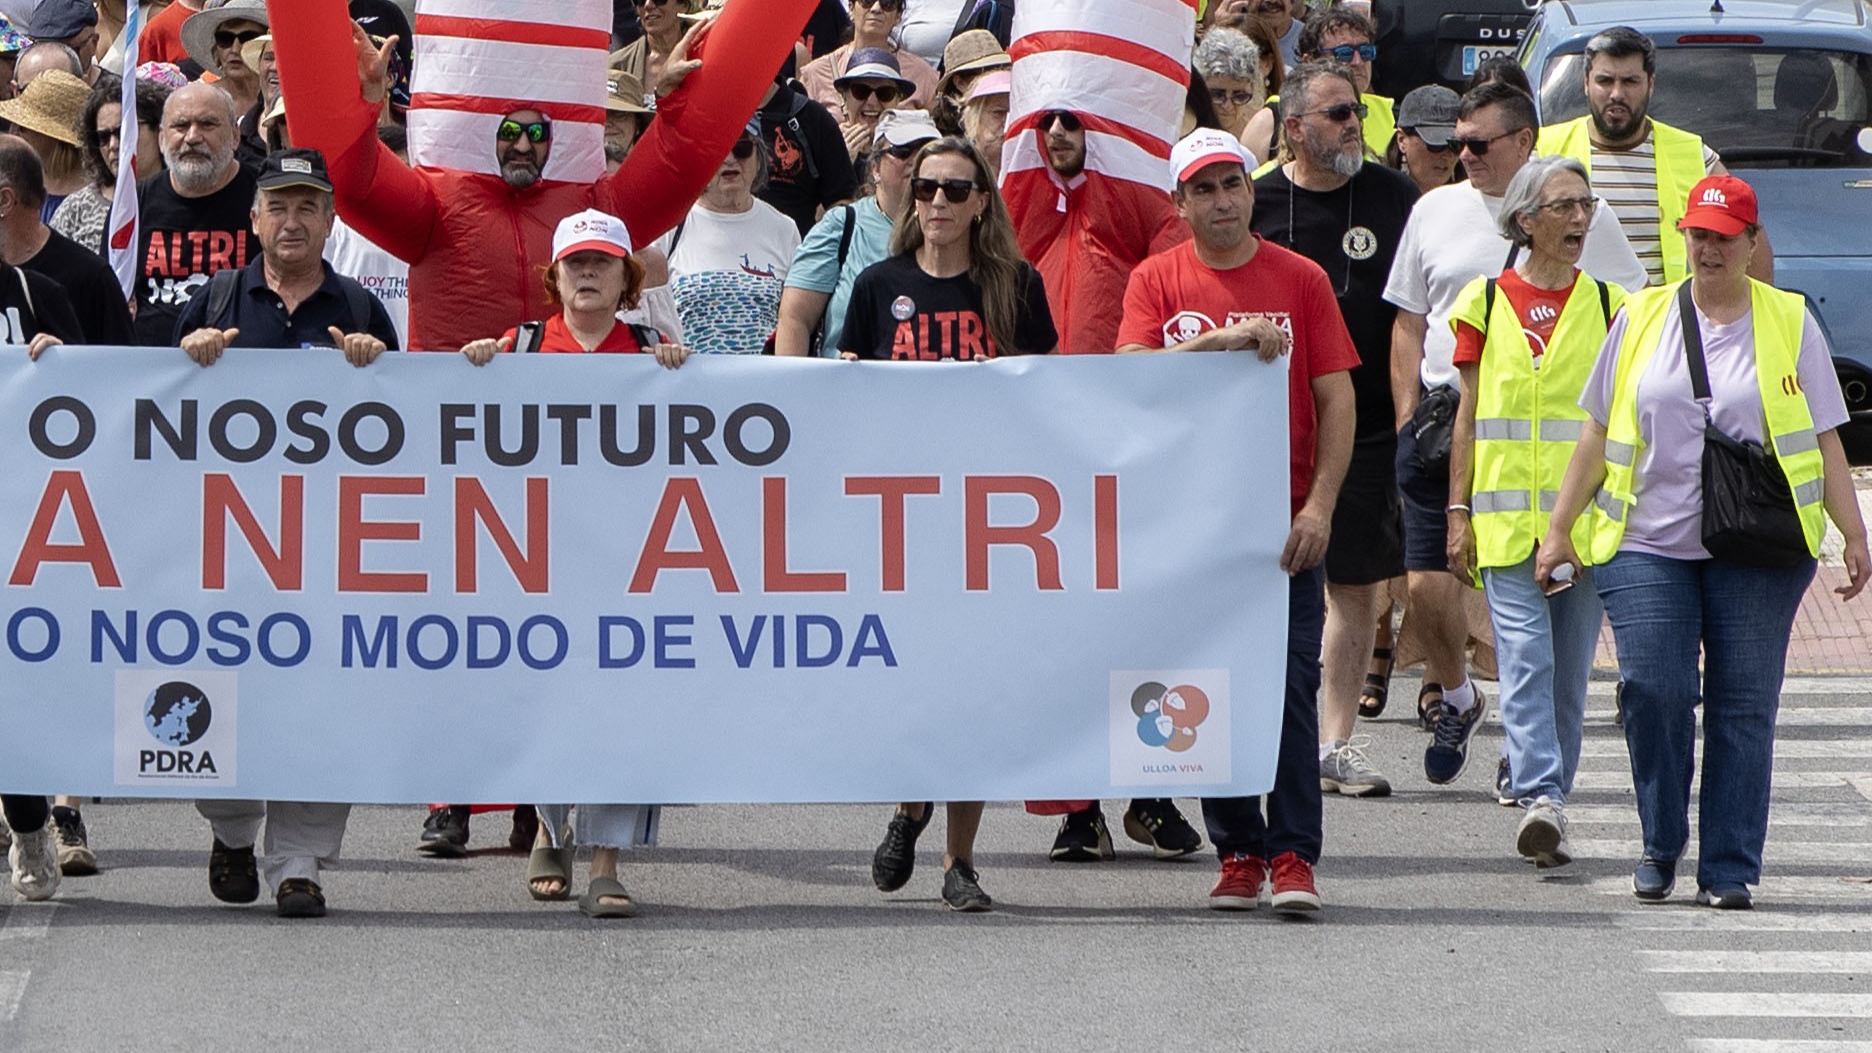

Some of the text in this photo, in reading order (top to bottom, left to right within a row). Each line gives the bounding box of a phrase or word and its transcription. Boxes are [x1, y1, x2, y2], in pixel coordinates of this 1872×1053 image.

[145, 229, 246, 277] ALTRI
[29, 396, 95, 459] O
[134, 399, 405, 465] NOSO
[440, 403, 791, 467] FUTURO
[201, 473, 549, 593] NEN
[628, 476, 1119, 593] ALTRI
[6, 607, 61, 663] O
[90, 610, 312, 668] NOSO
[341, 615, 569, 671] MODO
[598, 616, 696, 669] DE
[719, 615, 898, 668] VIDA
[140, 750, 217, 773] PDRA
[1143, 764, 1204, 773] ULLOA VIVA
